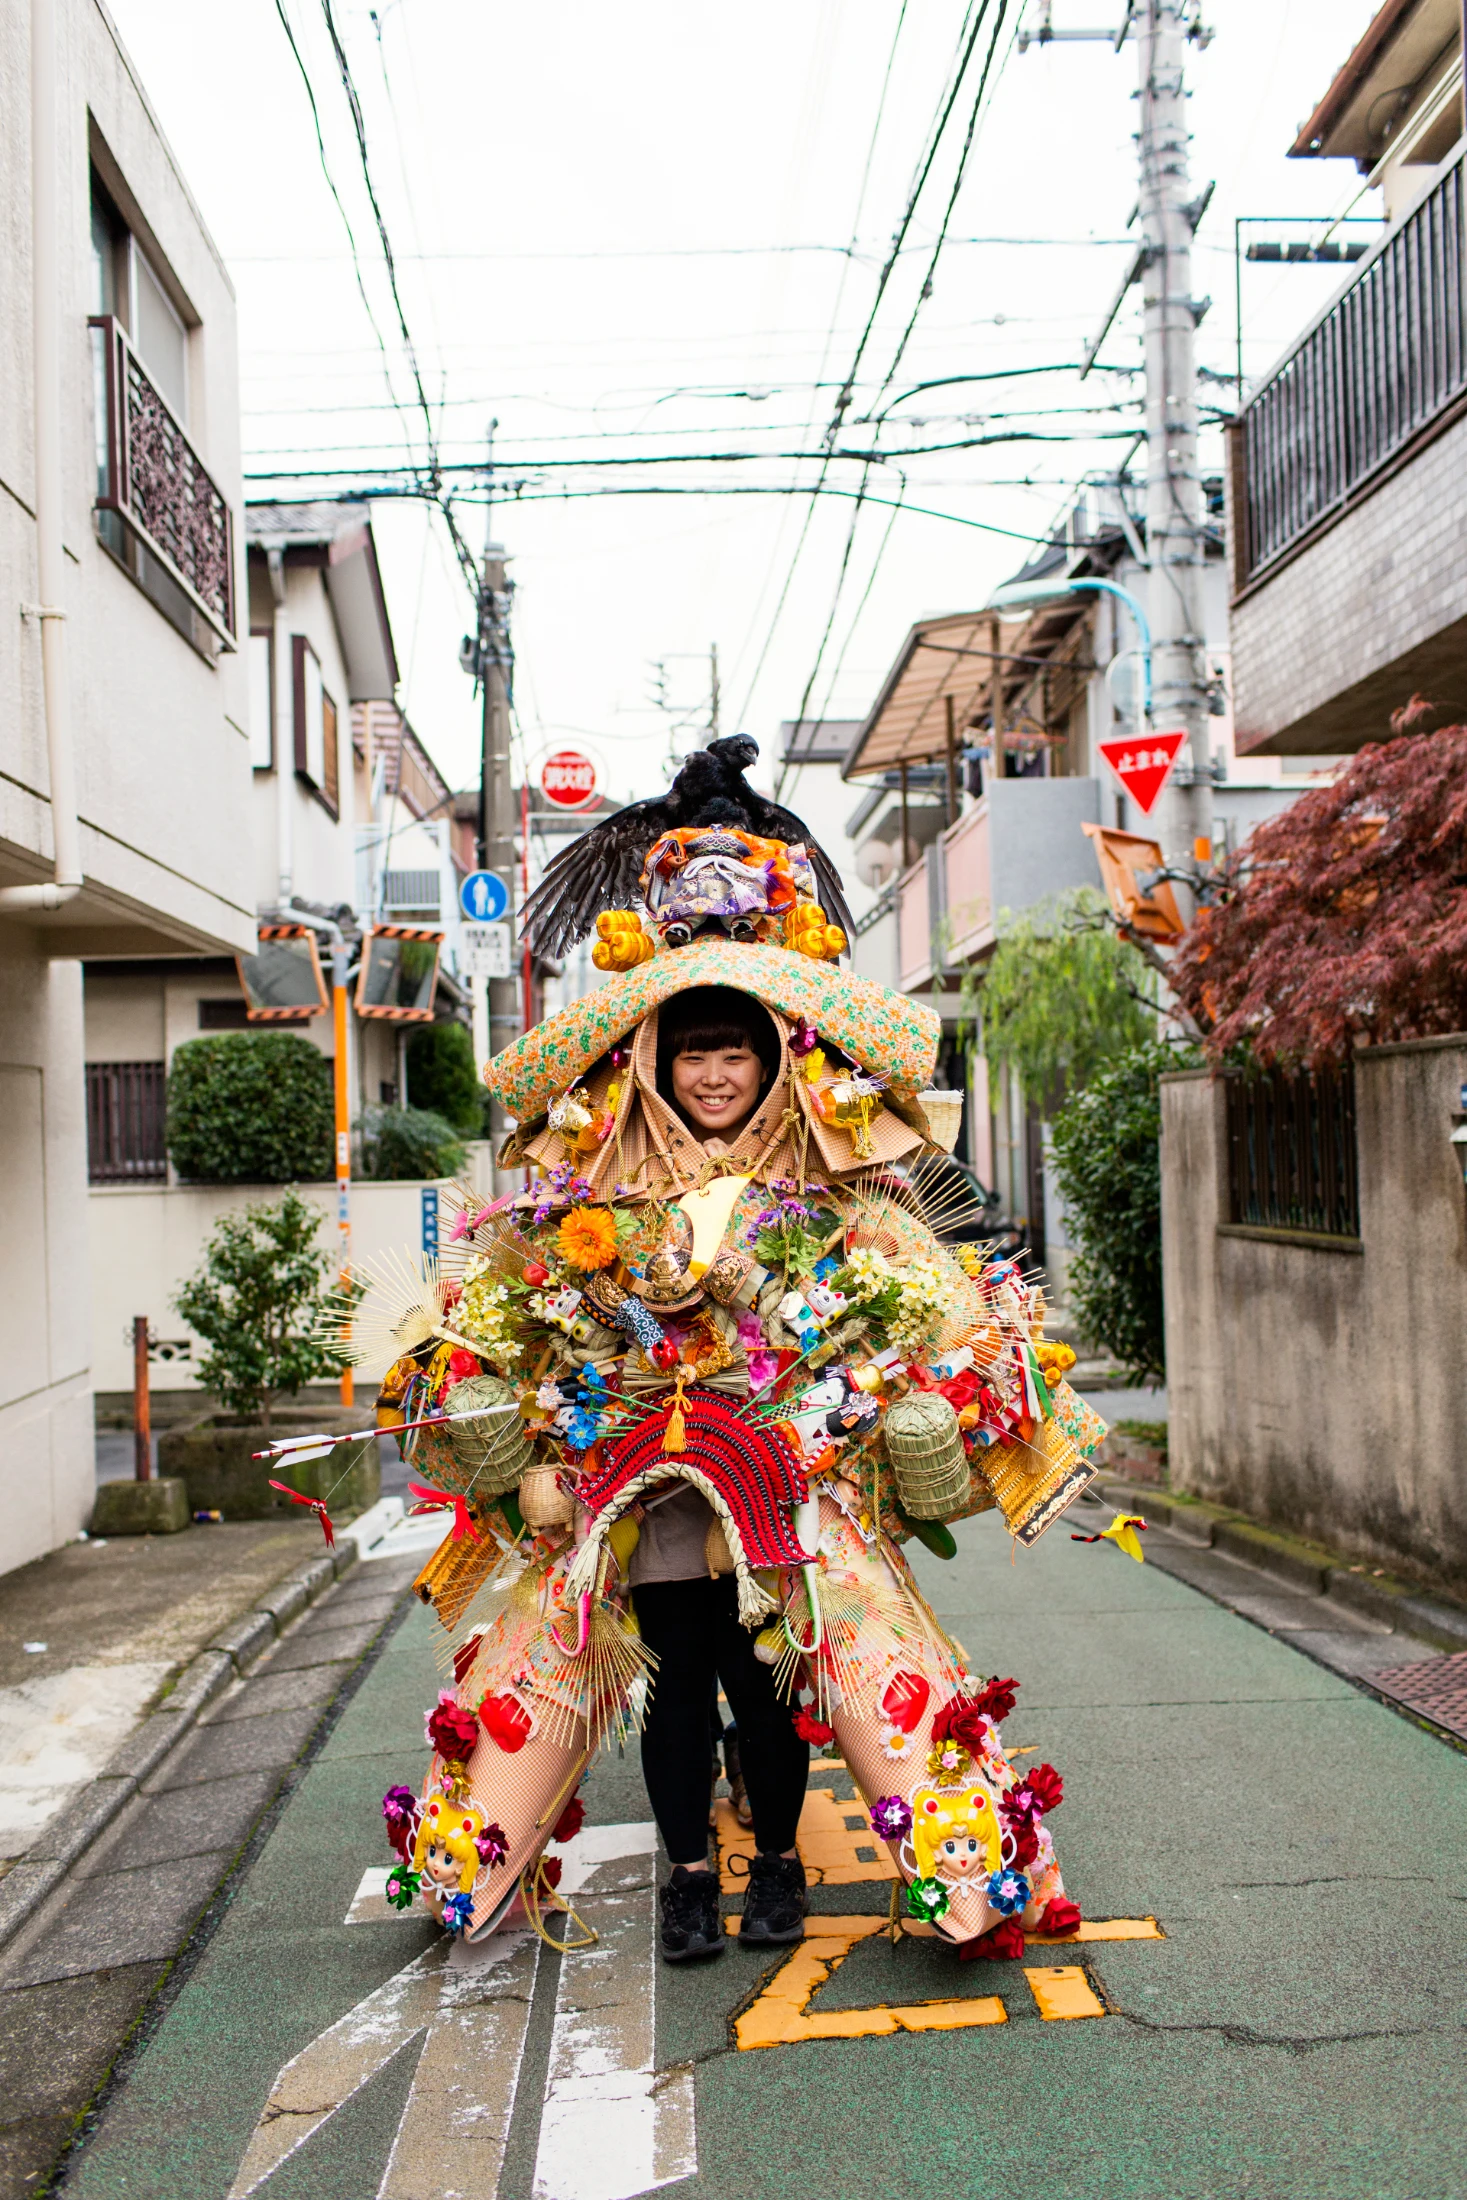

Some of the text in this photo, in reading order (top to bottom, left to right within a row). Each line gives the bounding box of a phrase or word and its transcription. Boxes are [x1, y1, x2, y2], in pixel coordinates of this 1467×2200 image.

[1117, 747, 1170, 774] 止まれ
[545, 766, 593, 790] 消火栓
